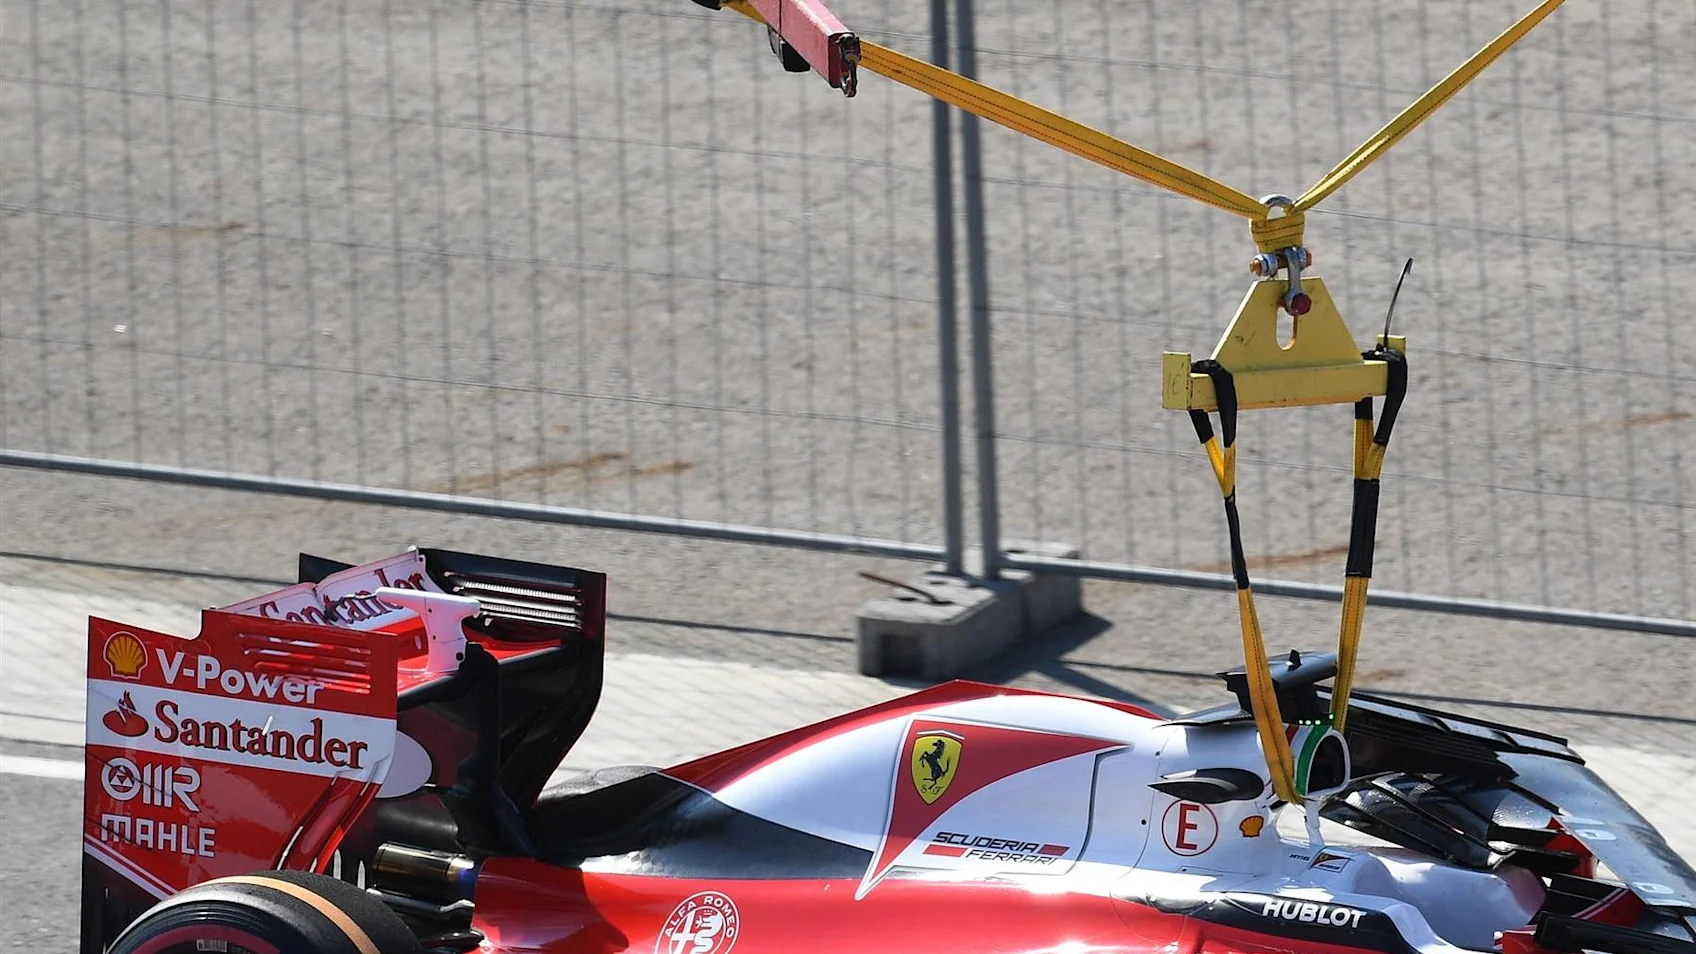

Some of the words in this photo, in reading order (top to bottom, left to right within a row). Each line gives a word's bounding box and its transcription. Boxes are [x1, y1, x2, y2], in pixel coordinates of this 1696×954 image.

[155, 647, 324, 704] V-Power
[154, 699, 368, 770] Santander
[101, 813, 215, 858] MAHLE
[932, 831, 1041, 855] SCUDERIA
[1175, 801, 1199, 851] E
[965, 848, 1059, 867] FERRARI
[664, 899, 697, 938] ALFA
[703, 895, 735, 939] ROMEO
[1261, 898, 1367, 930] HUBLOT
